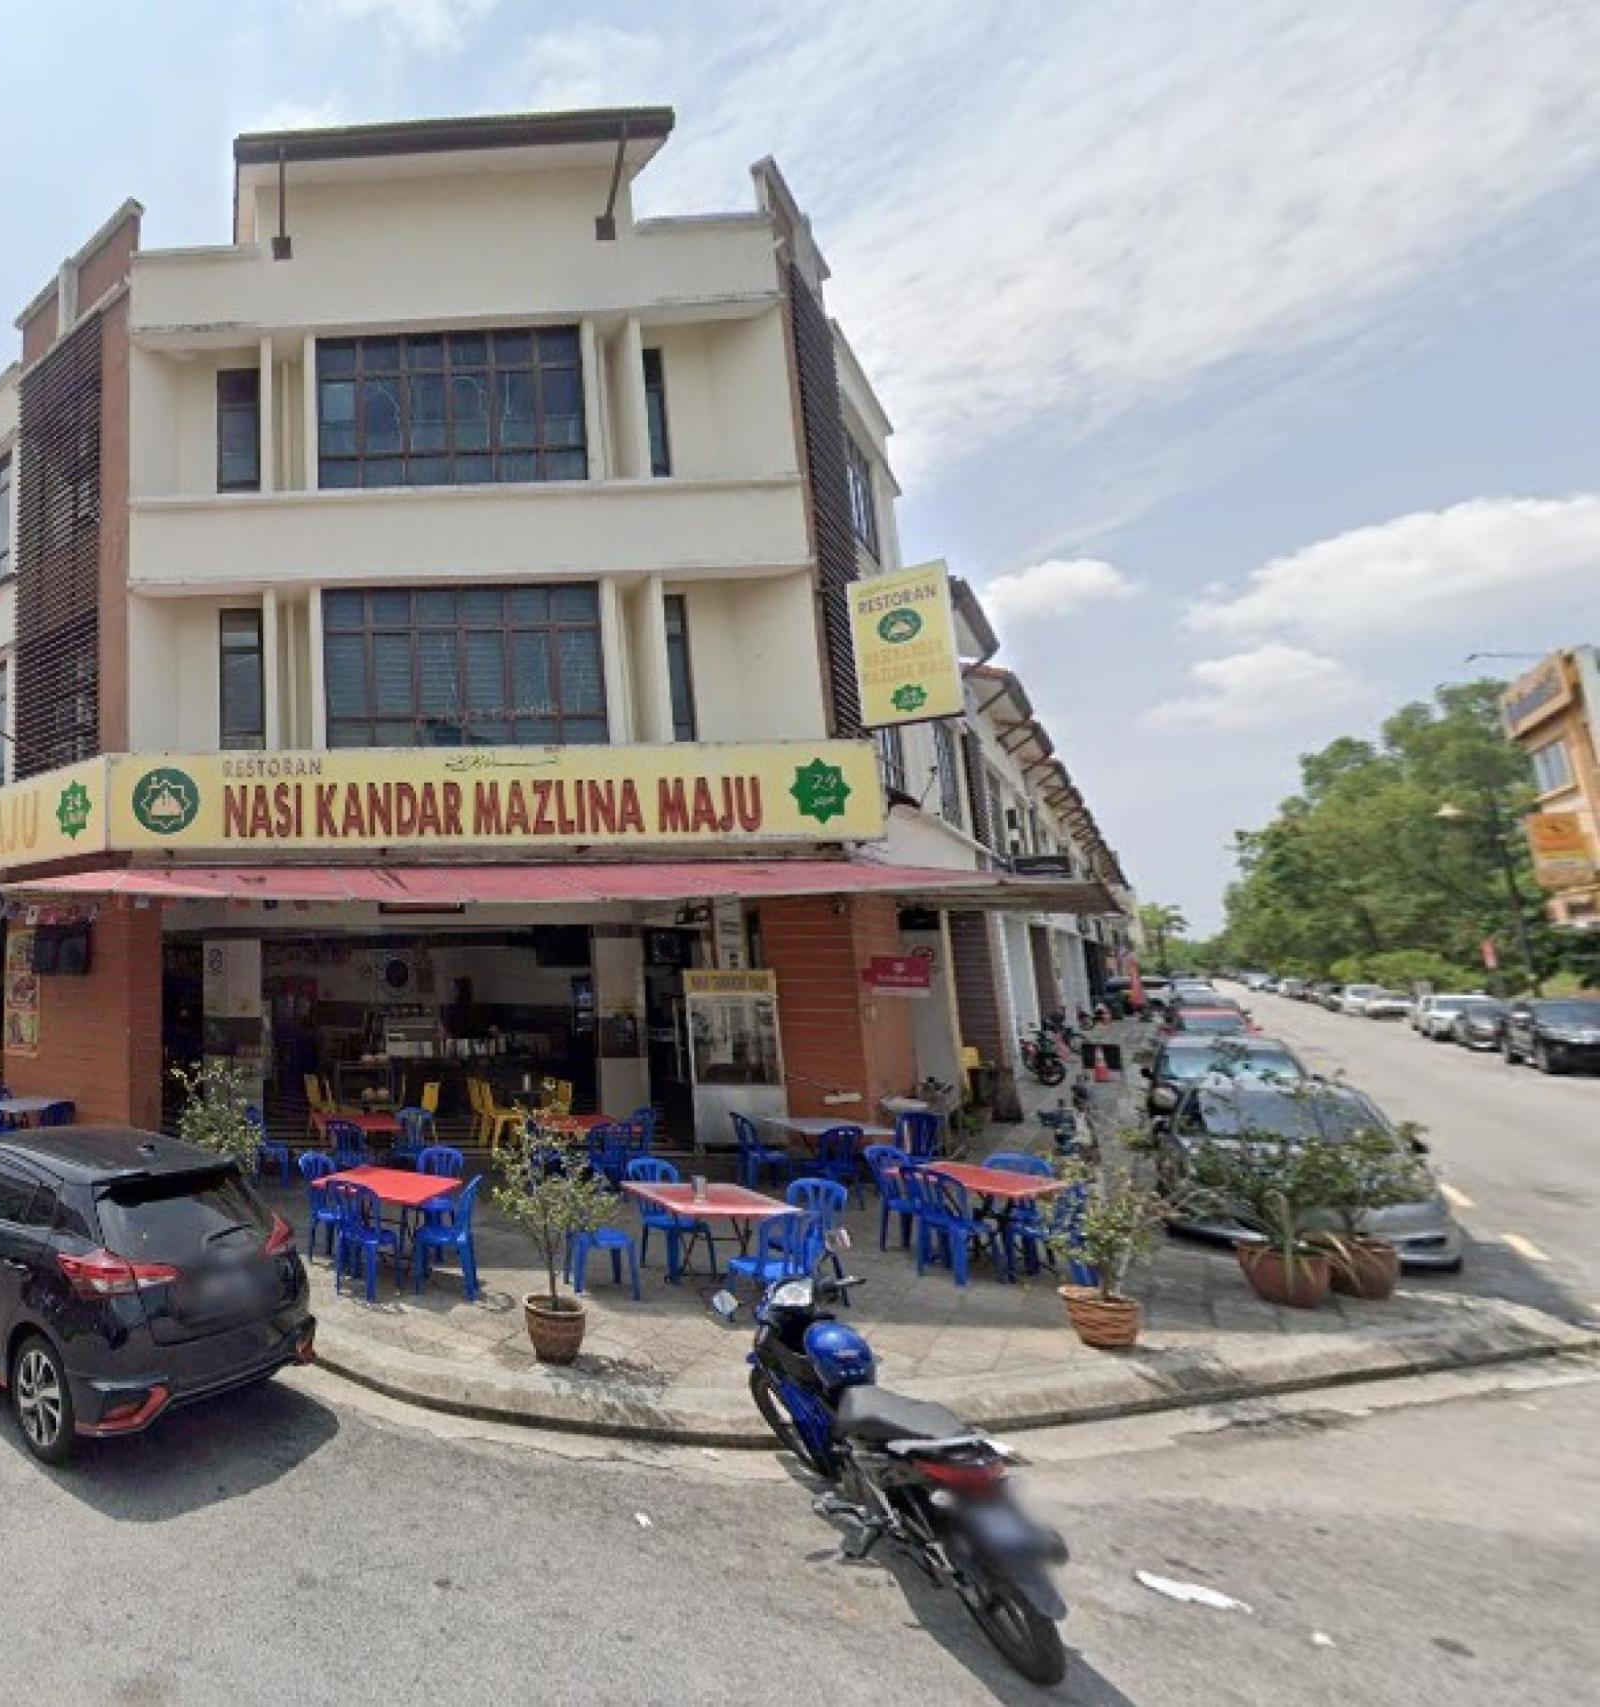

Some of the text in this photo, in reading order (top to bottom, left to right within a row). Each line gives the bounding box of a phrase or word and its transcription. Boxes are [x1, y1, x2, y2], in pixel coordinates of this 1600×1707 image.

[858, 583, 938, 615] RESTORAN
[221, 757, 322, 779] RESTORAN
[223, 774, 764, 838] NASI KANDAR MAZLINA MAJU
